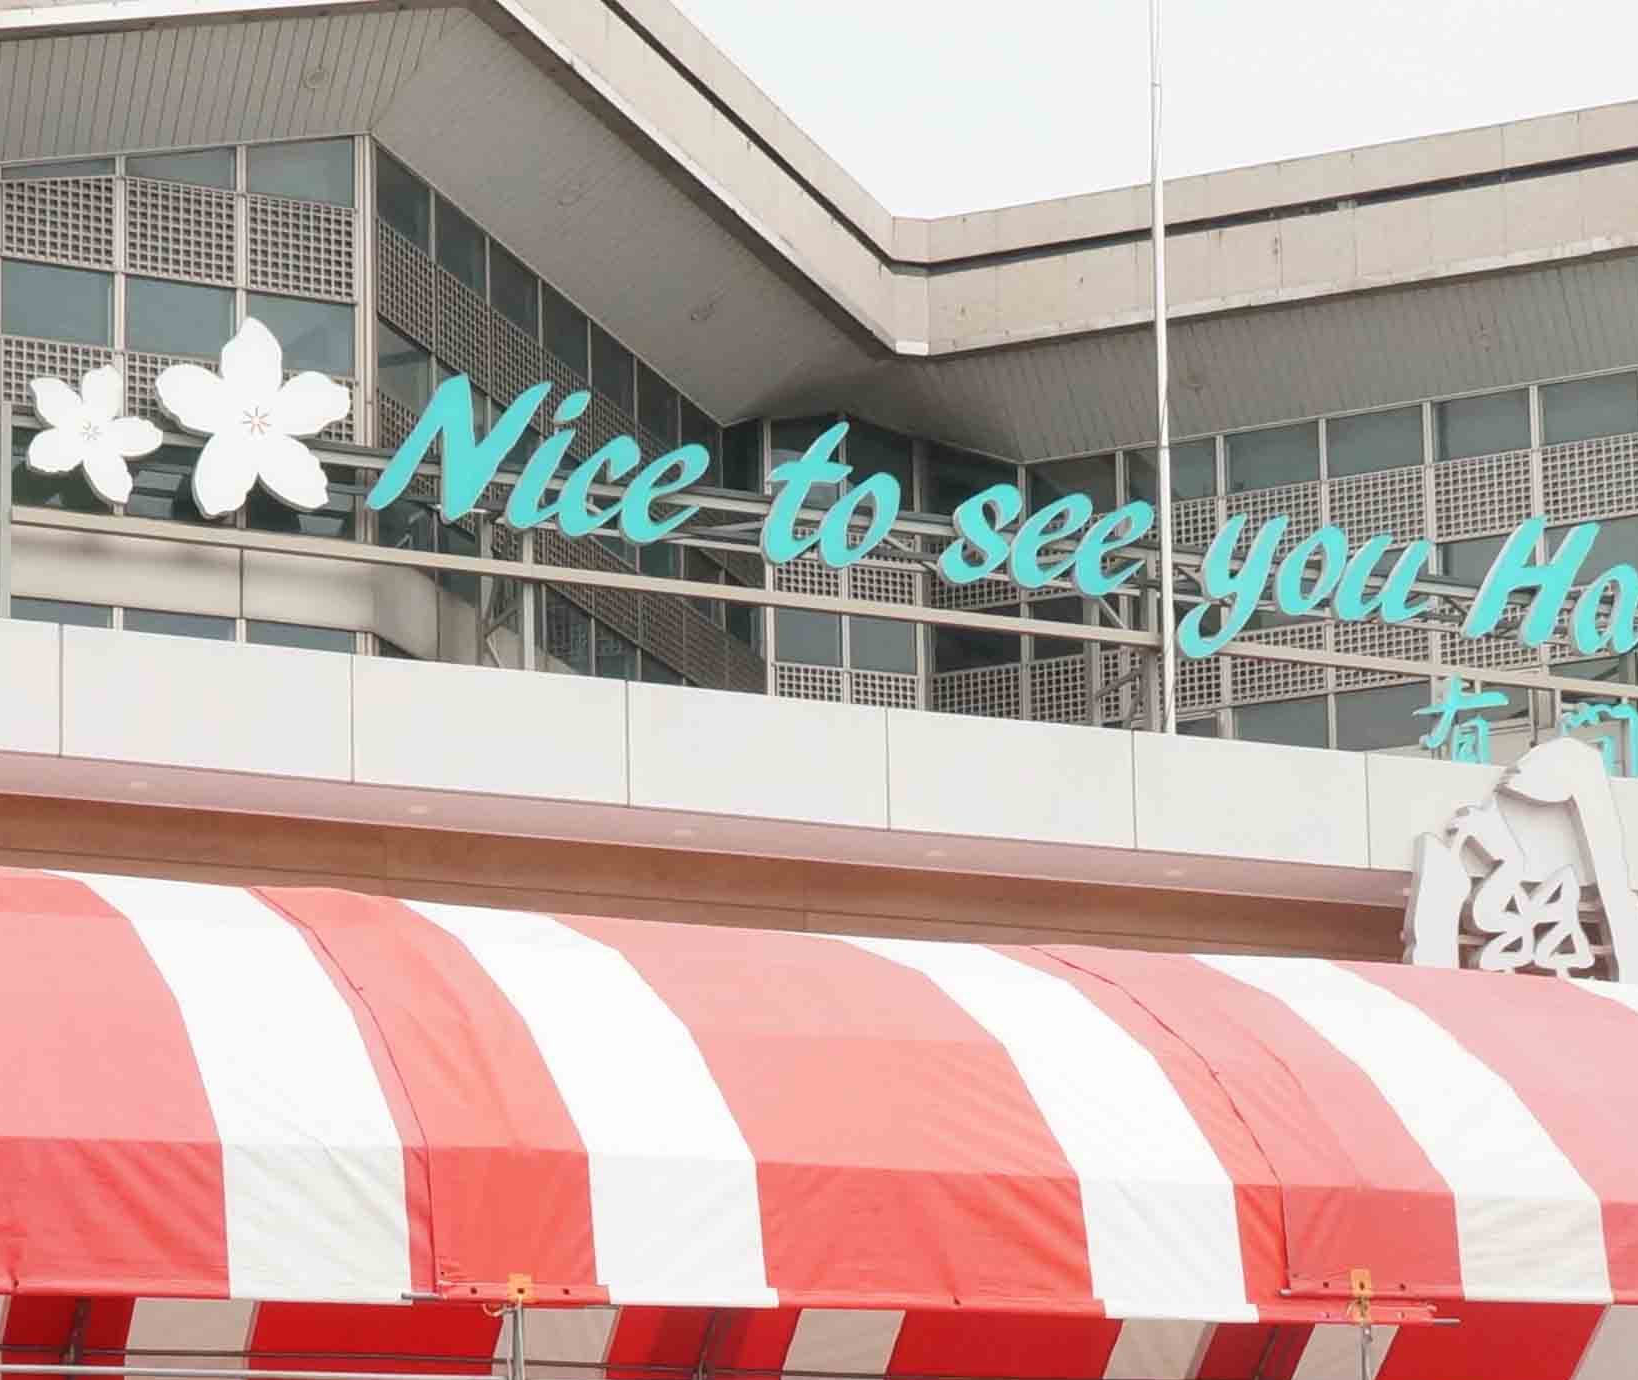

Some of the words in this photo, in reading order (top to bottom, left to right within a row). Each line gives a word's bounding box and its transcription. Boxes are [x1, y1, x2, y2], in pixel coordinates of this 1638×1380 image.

[368, 372, 710, 544] Nice
[765, 422, 902, 568] to
[942, 482, 1155, 599] see
[1179, 513, 1431, 658] you
